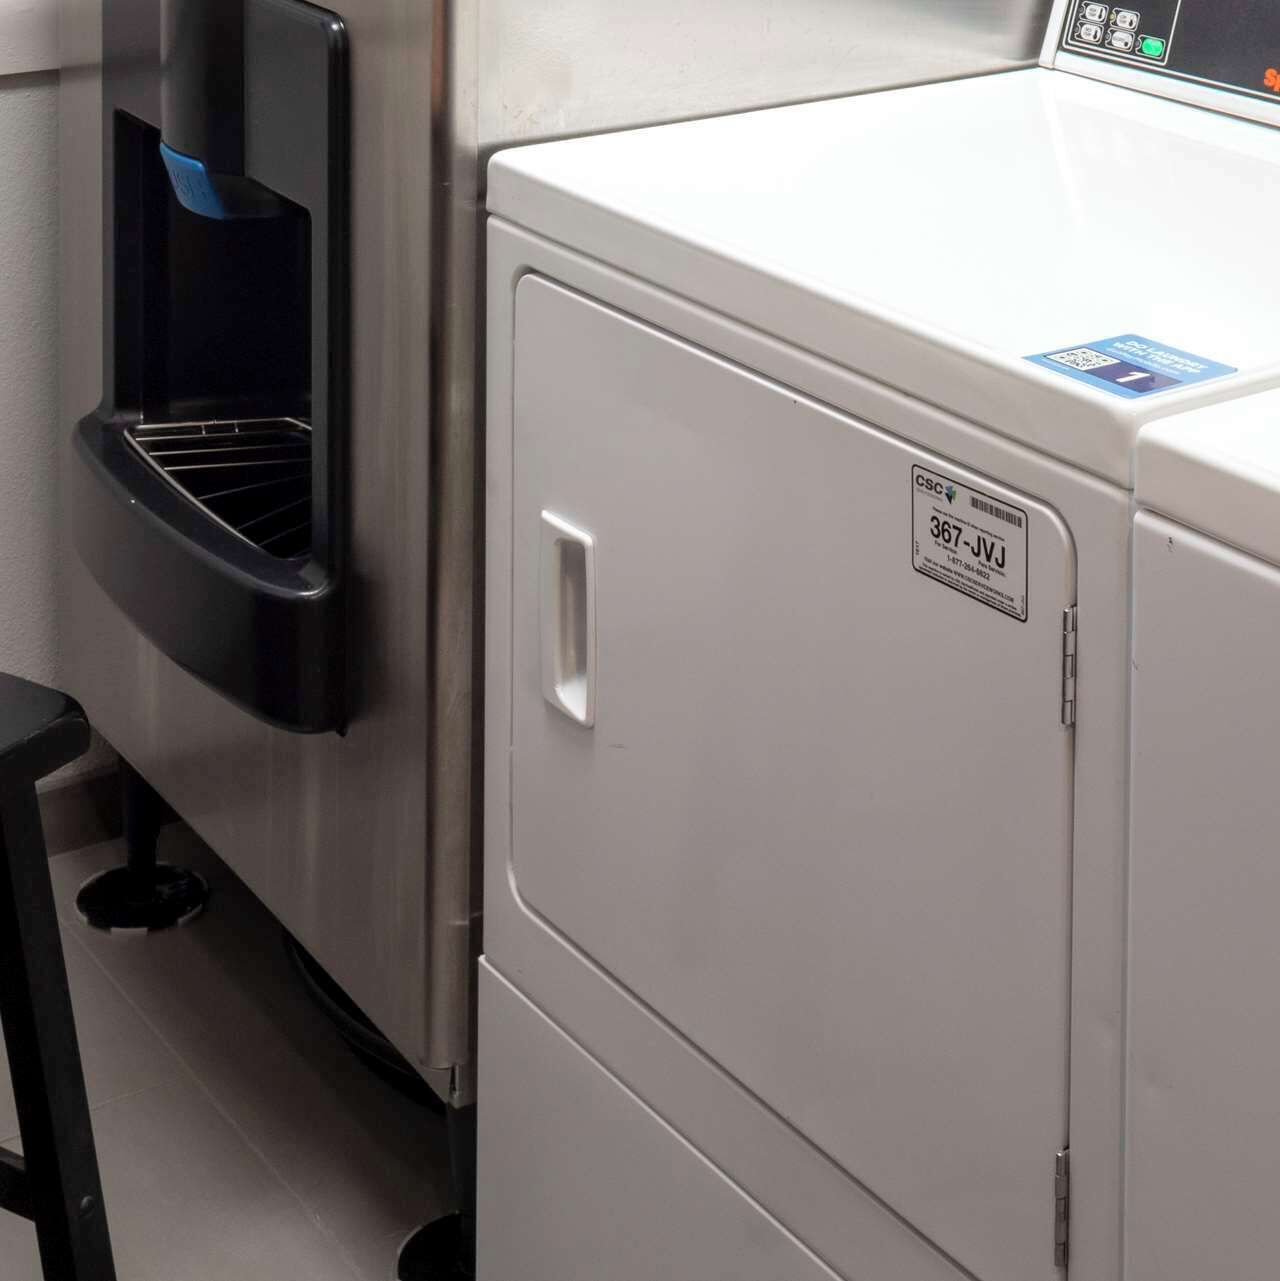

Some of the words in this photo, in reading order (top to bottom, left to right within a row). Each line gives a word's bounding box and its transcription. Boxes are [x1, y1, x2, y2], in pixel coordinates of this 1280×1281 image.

[1115, 372, 1151, 382] 1
[915, 474, 944, 495] CSC
[930, 516, 1005, 569] 367-JVJ
